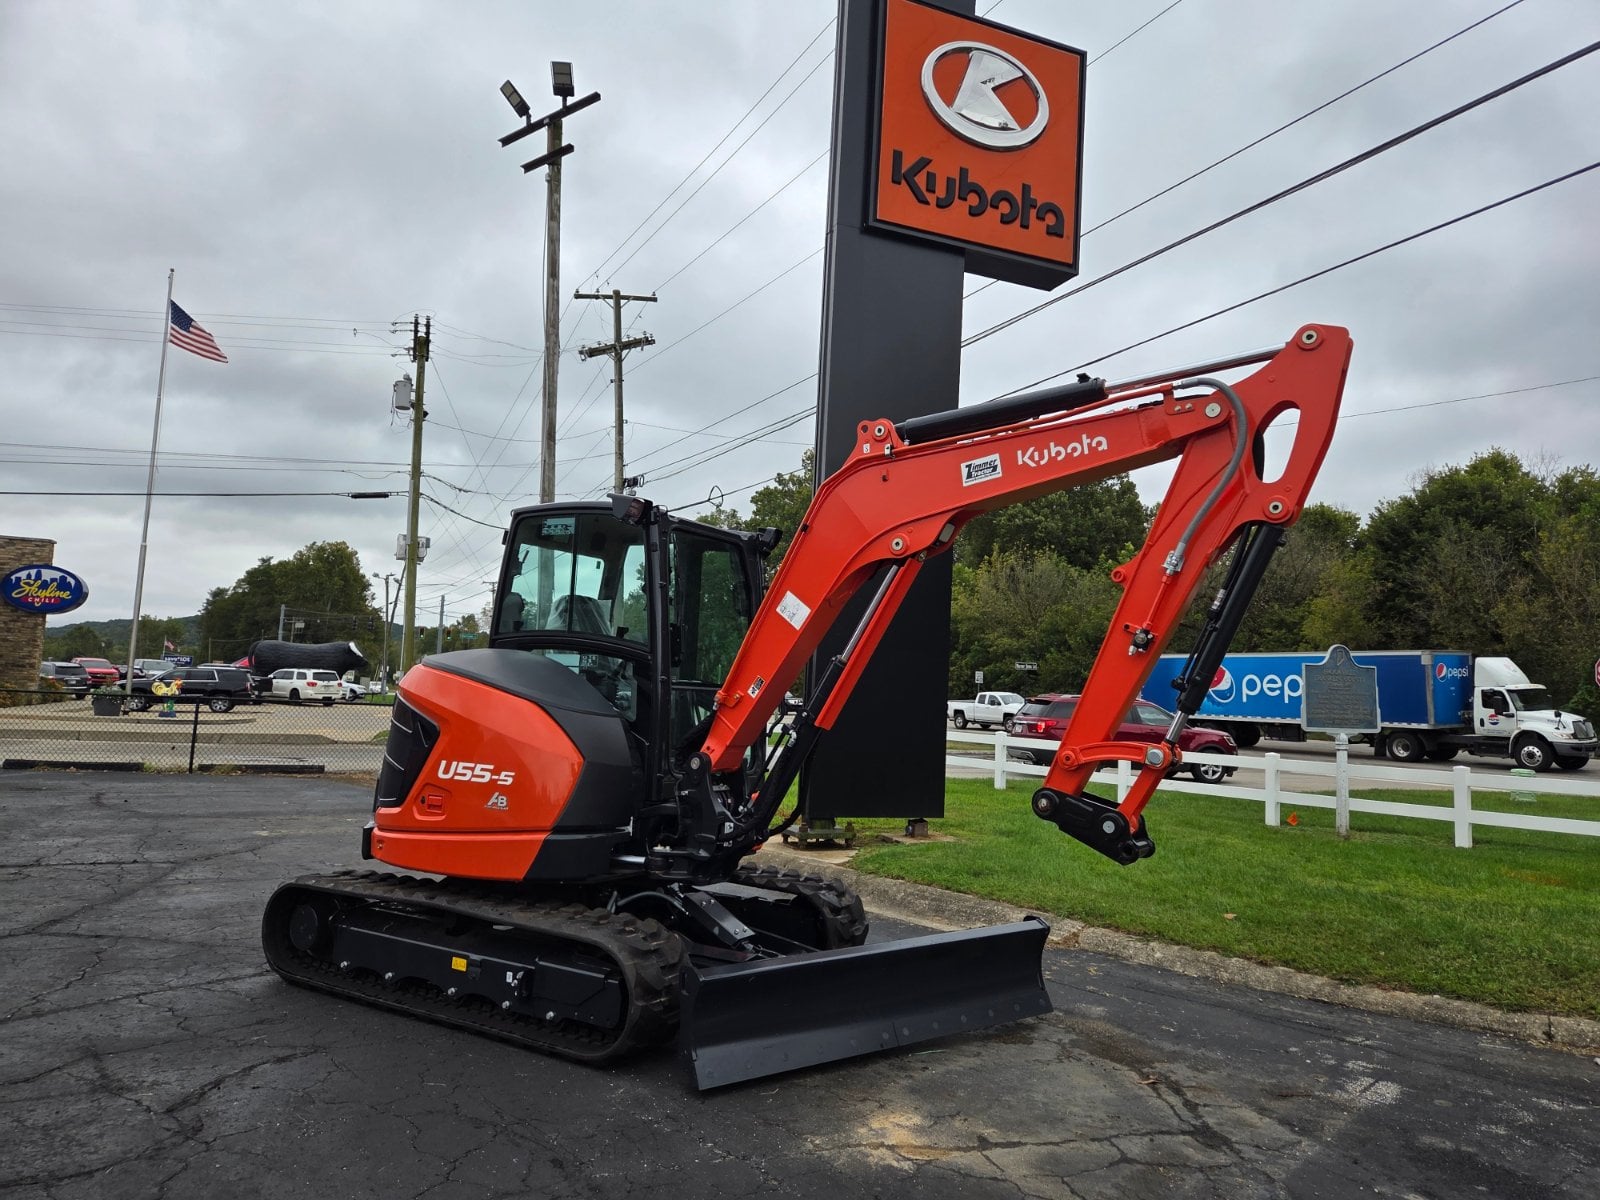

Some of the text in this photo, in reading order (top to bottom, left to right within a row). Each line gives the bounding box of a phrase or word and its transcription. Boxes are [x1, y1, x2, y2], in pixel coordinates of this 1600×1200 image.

[891, 149, 1065, 239] Kubota
[1016, 433, 1108, 467] Kubota
[11, 579, 72, 607] Skyline
[27, 596, 55, 604] CHILI
[1447, 665, 1469, 680] pepsi
[1241, 673, 1302, 703] pep
[437, 760, 516, 787] U55-5
